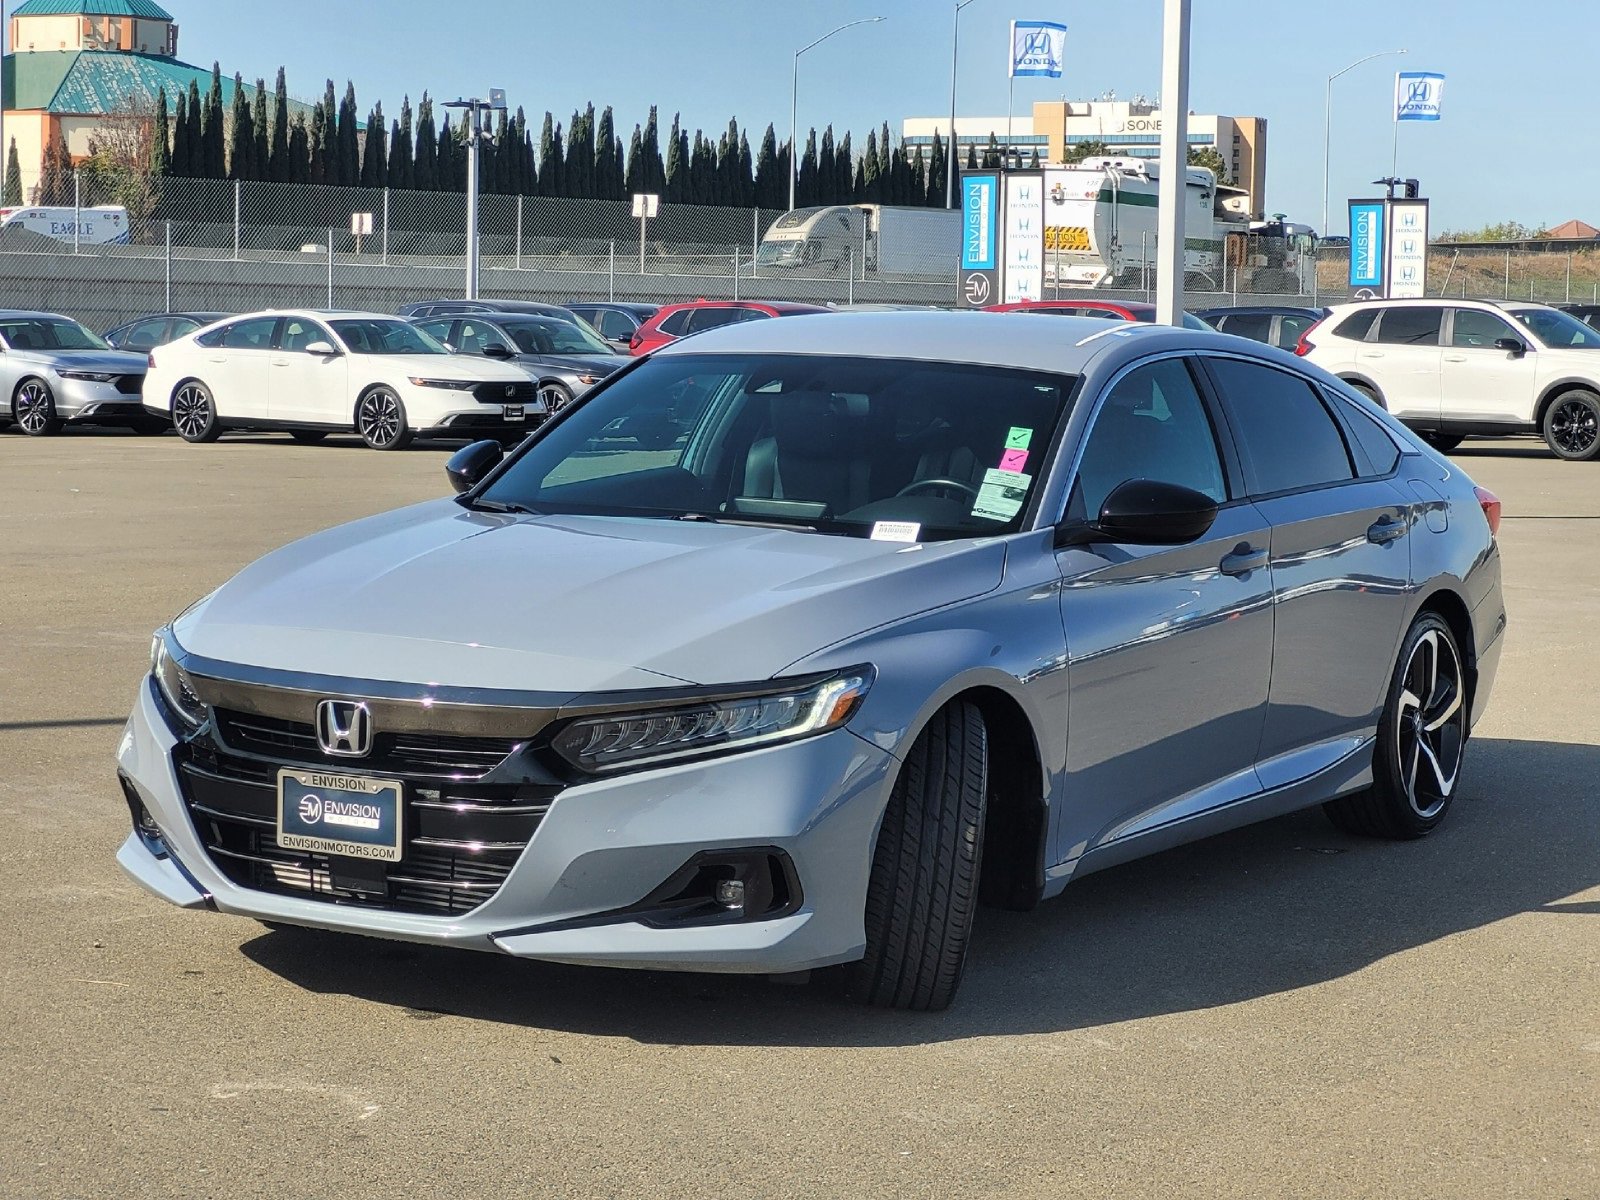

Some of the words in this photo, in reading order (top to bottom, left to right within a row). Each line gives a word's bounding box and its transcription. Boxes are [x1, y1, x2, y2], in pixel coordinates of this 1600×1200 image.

[1014, 58, 1058, 66] HONDA
[51, 222, 94, 235] EAGLE
[968, 184, 981, 263] ENVISION
[1046, 232, 1076, 242] AUTION
[1356, 211, 1368, 280] ENVISION
[312, 775, 366, 791] ENVISION
[324, 800, 380, 819] ENVISION
[283, 836, 395, 860] ENVISIONMOTORS.COM
